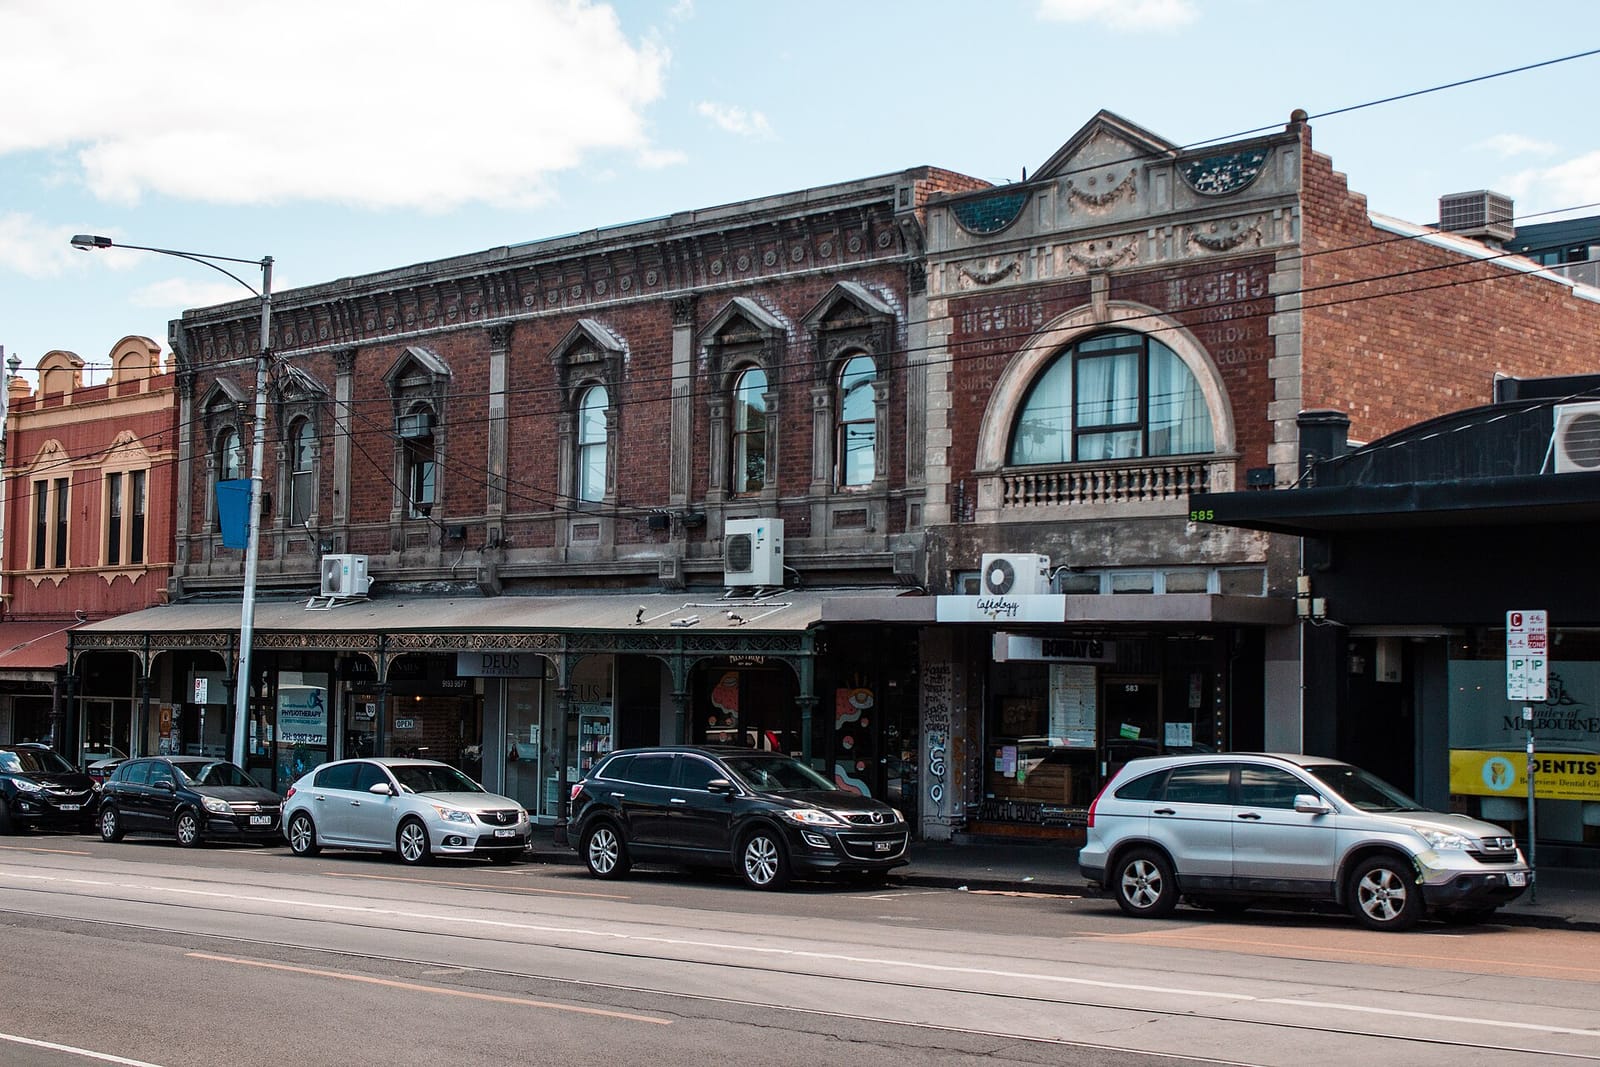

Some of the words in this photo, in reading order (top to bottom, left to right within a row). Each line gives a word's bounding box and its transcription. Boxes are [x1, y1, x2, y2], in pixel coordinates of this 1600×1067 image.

[1190, 510, 1214, 521] 585
[482, 654, 519, 669] DEUS
[1512, 660, 1523, 670] 1P
[1532, 660, 1542, 670] 1P
[281, 709, 321, 718] PHYSIOTHERAPY
[1533, 760, 1600, 775] DENTIS
[1559, 779, 1585, 787] Dental
